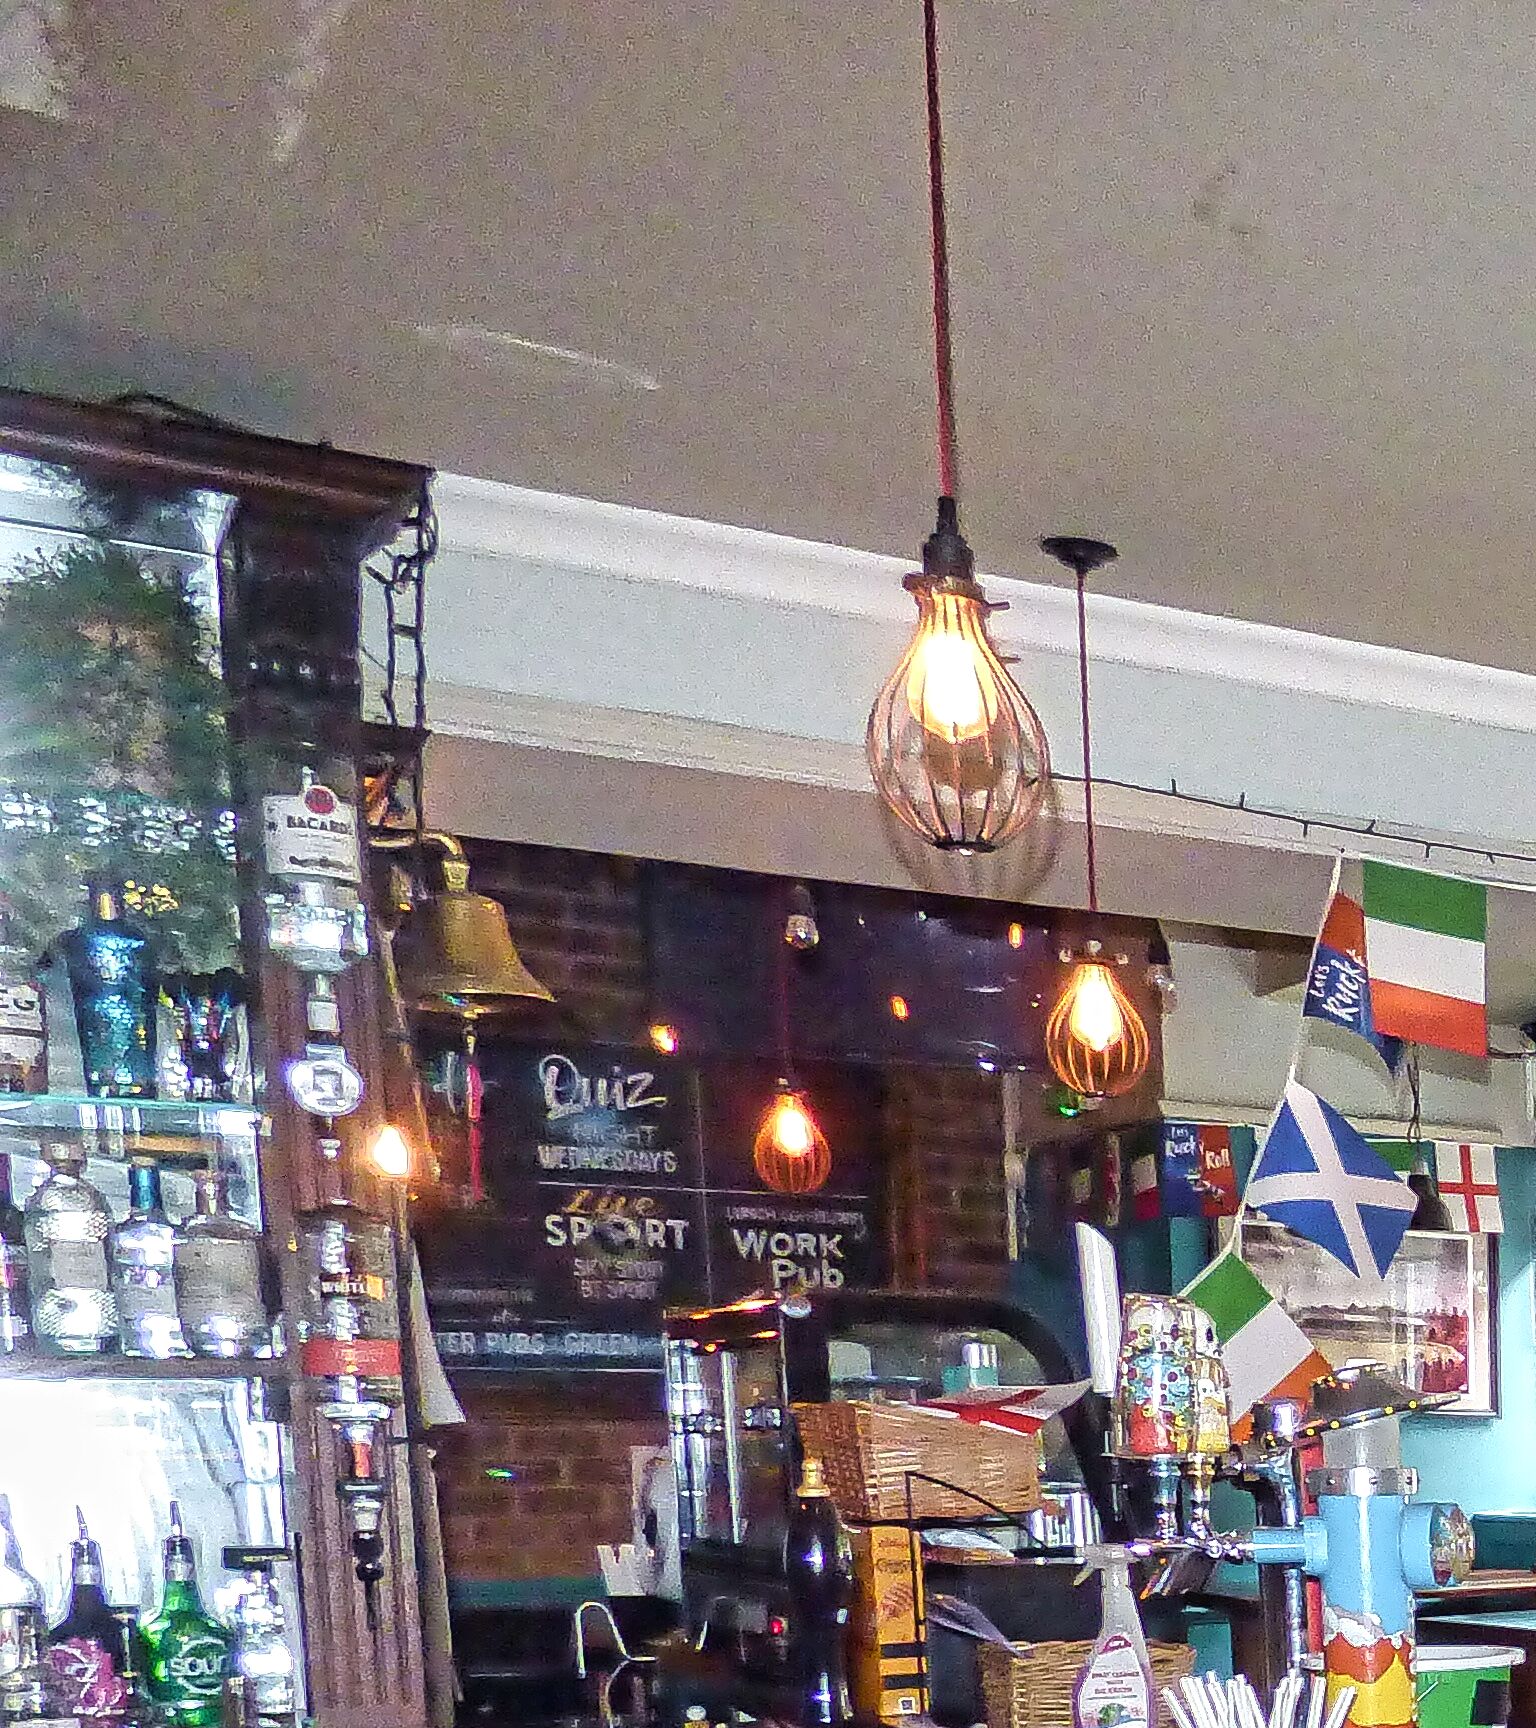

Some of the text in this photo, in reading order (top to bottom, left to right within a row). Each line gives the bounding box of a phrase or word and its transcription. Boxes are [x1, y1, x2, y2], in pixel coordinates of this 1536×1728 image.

[1322, 959, 1367, 1022] Ruck
[538, 1053, 668, 1120] Quiz
[732, 1228, 845, 1264] WORK
[771, 1258, 845, 1289] Pub
